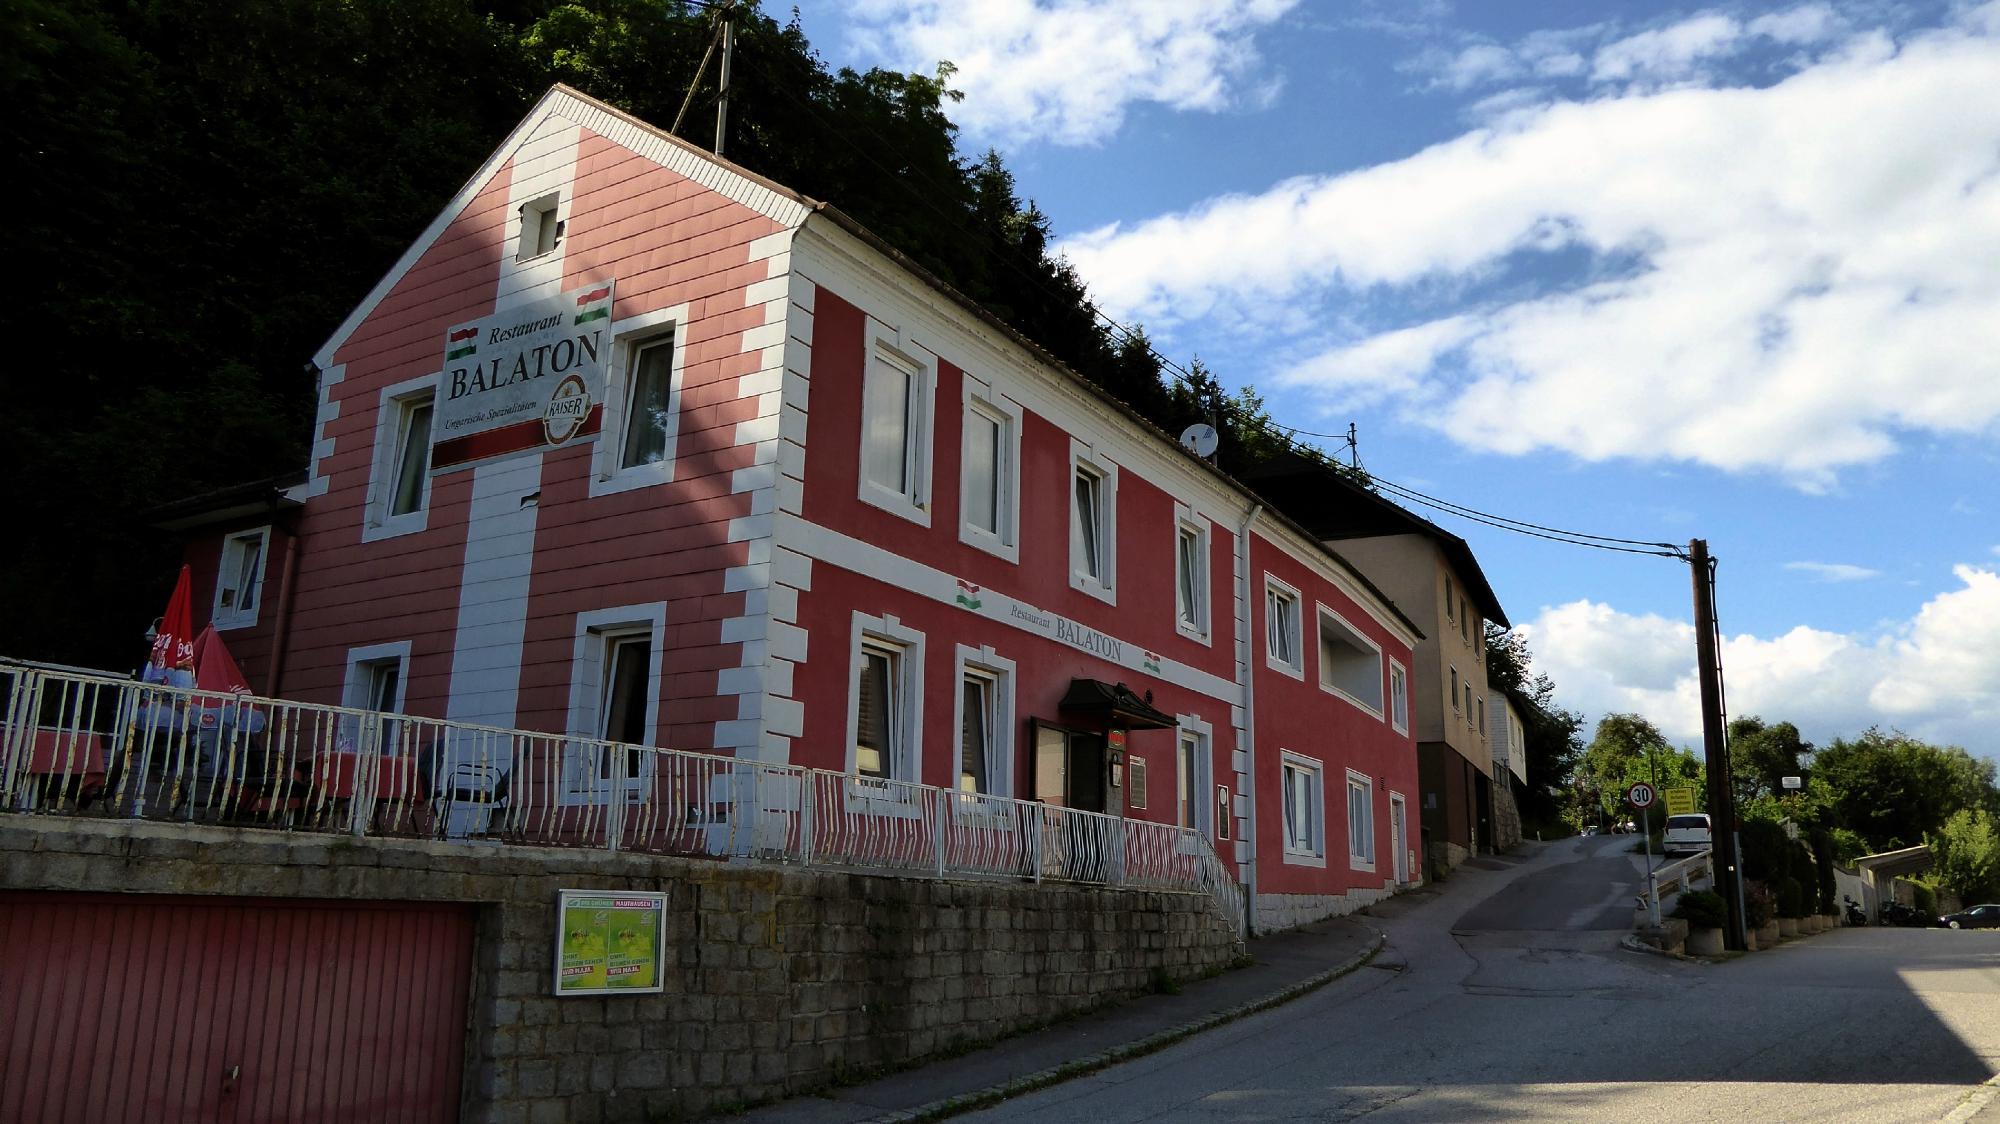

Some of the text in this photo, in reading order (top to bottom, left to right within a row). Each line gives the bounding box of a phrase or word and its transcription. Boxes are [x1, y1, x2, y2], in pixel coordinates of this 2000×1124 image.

[488, 312, 563, 345] Restaurant
[448, 330, 602, 400] BALATON
[549, 397, 582, 417] KAISER
[445, 413, 486, 430] Ungarische
[1010, 604, 1121, 661] Restaurant BALATON
[1634, 788, 1649, 802] 30
[615, 900, 651, 908] MAUTHAUSEN
